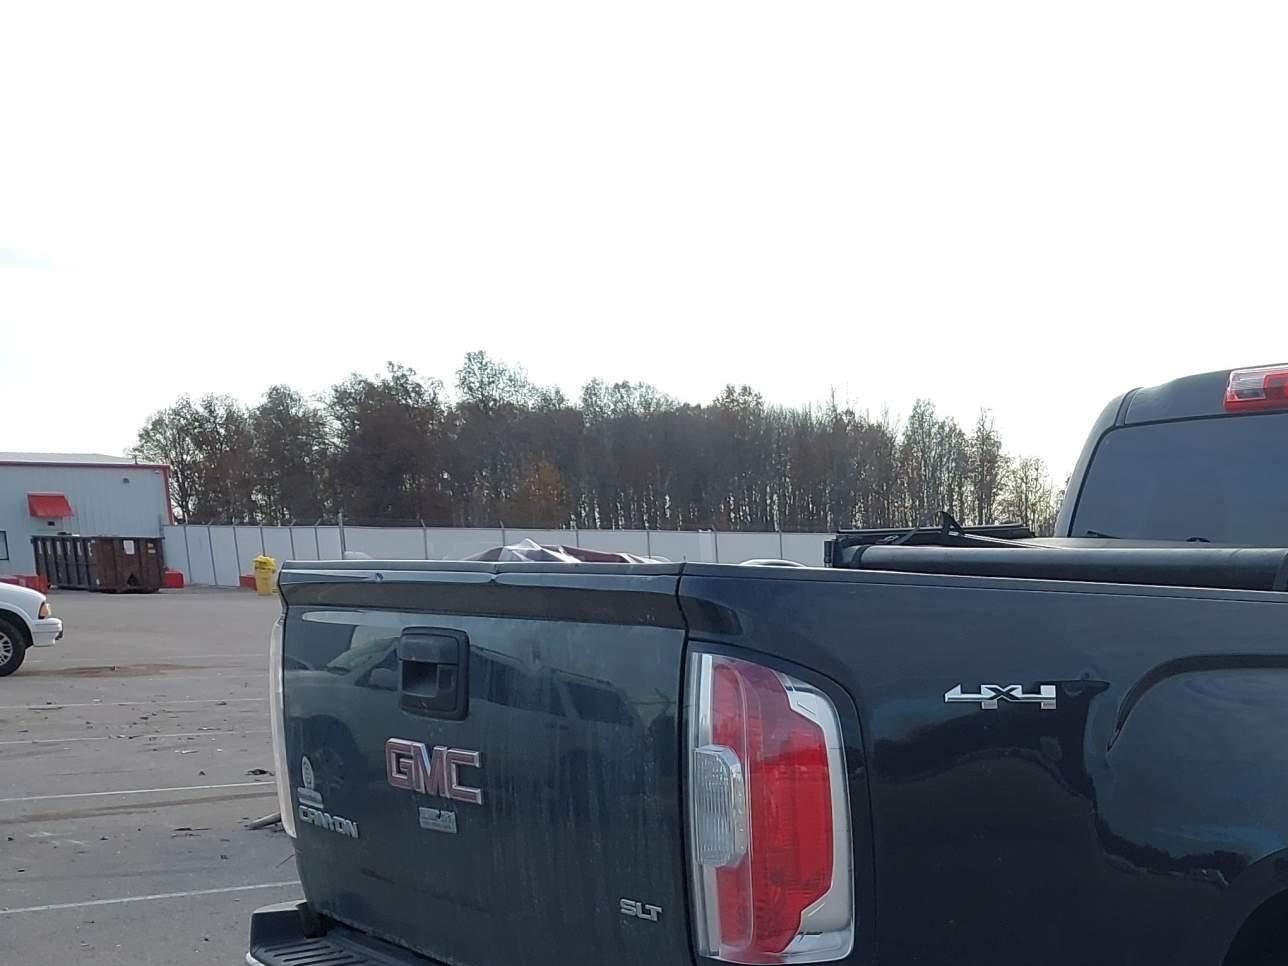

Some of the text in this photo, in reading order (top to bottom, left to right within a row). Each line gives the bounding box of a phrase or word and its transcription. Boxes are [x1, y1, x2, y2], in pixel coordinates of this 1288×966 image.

[385, 738, 482, 805] GMC
[299, 805, 359, 839] CANYON
[620, 898, 662, 921] SLT
